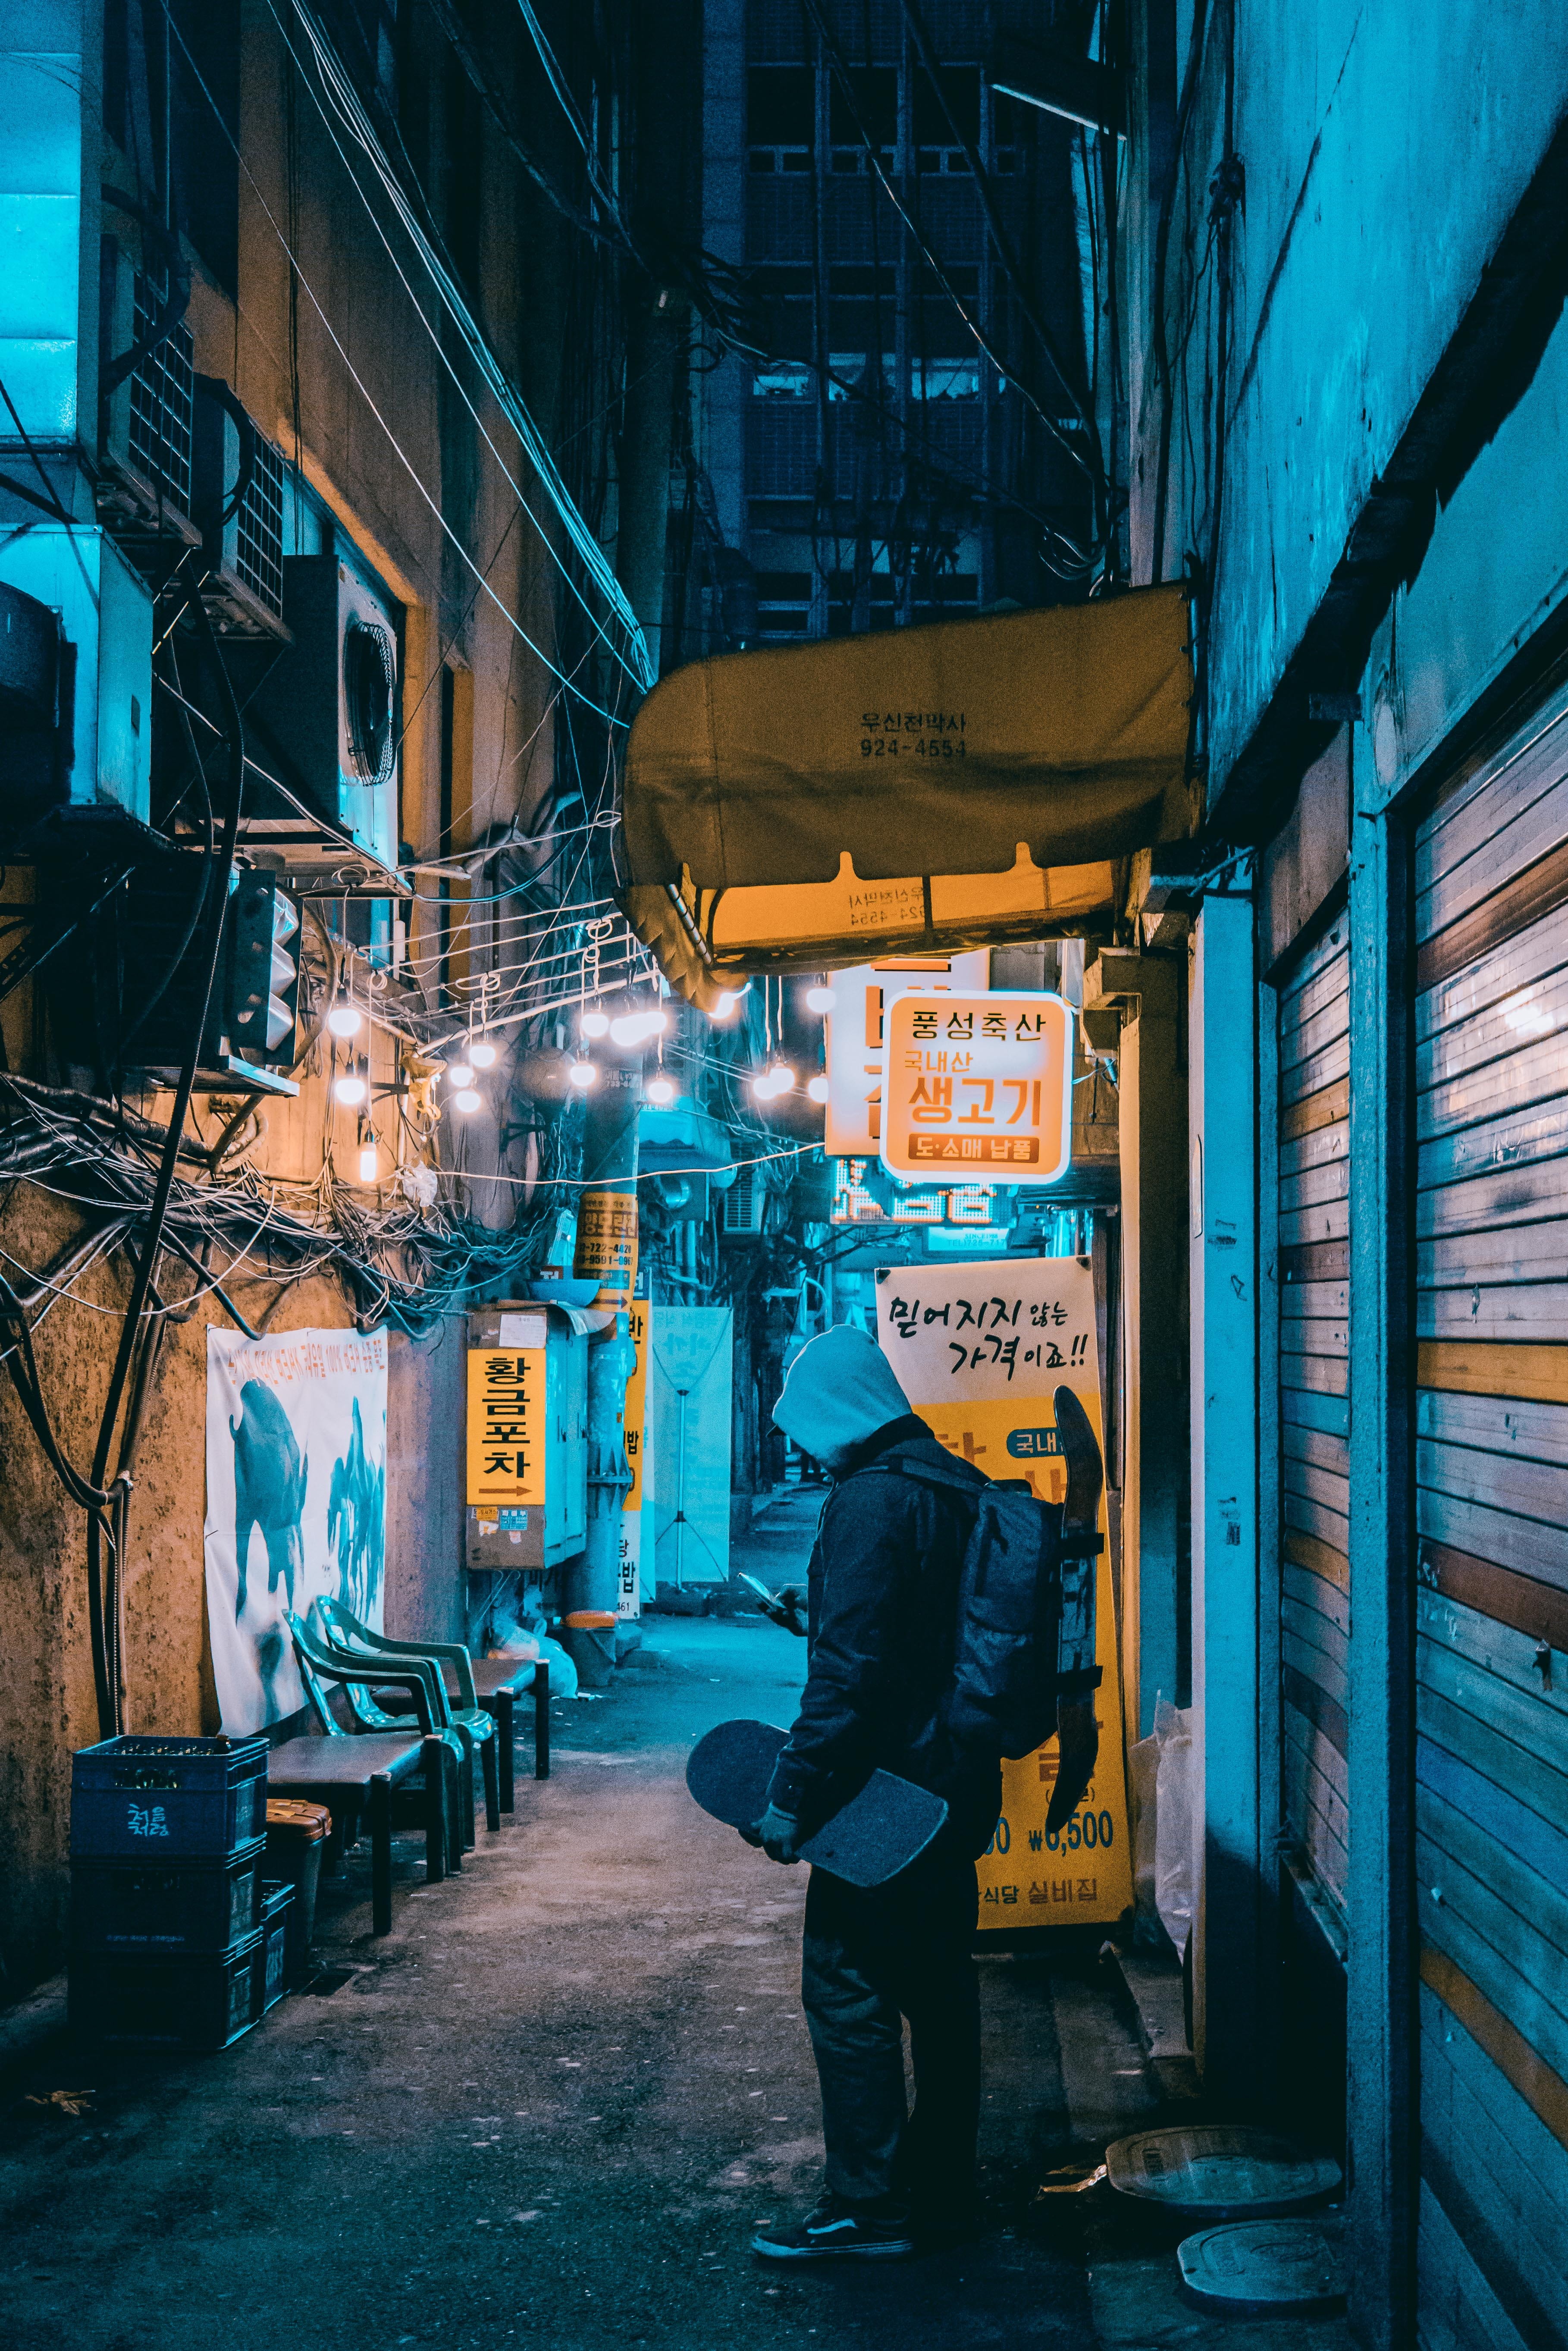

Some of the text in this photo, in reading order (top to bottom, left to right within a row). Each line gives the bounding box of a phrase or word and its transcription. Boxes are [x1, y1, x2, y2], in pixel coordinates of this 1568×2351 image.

[861, 739, 965, 756] 924-4554
[913, 1011, 1046, 1041] 풍성축산
[905, 1050, 973, 1072] 국내산
[909, 1077, 1041, 1126] 생고기
[991, 1139, 1031, 1160] 납품
[889, 1297, 1068, 1338] 믿어지지 않는
[482, 1357, 531, 1478] 황금포차
[1016, 1433, 1064, 1454] 국내
[978, 1878, 1098, 1905] 식당 실비집
